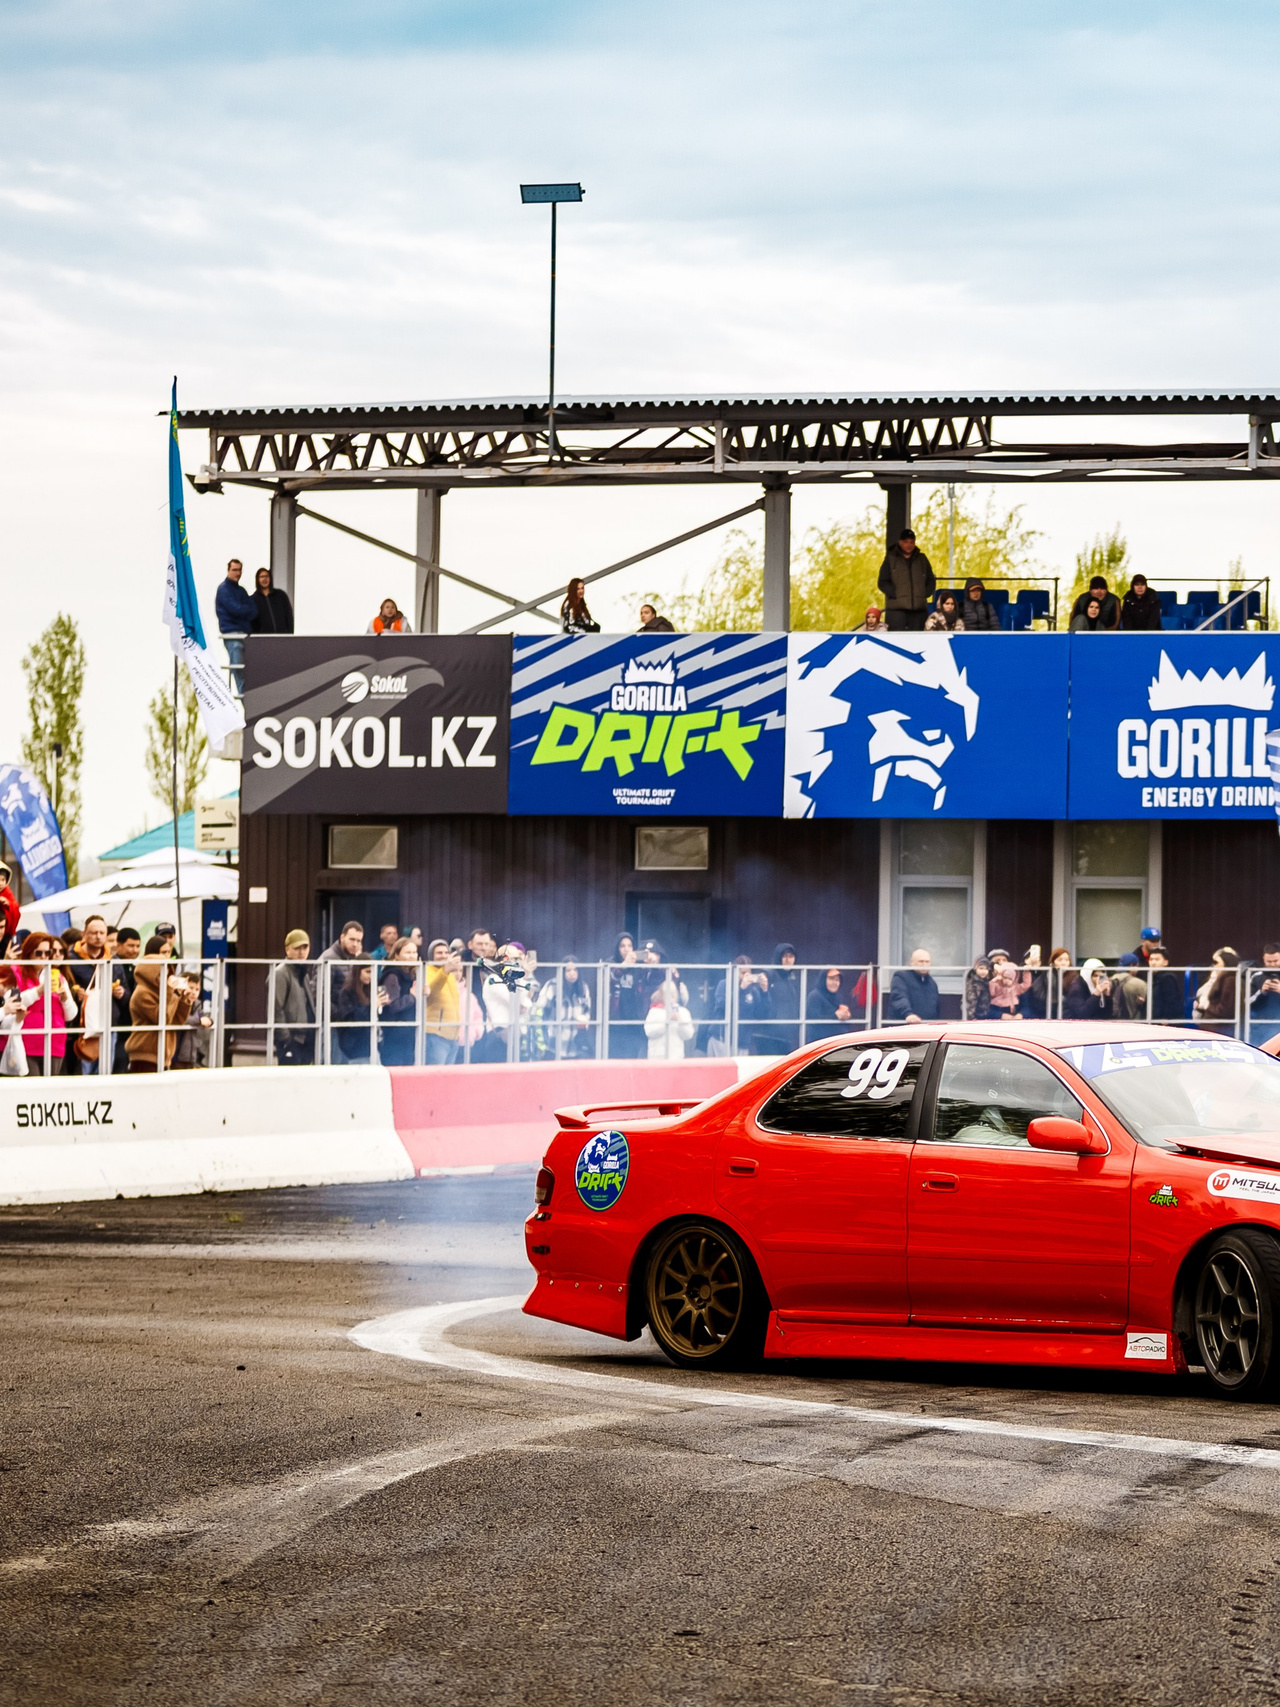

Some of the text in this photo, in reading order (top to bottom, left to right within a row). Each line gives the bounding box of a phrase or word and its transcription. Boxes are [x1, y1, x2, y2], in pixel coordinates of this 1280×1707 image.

[611, 685, 687, 712] GORILLA
[252, 716, 498, 769] SOKOL.KZ
[530, 705, 762, 782] DRIFT
[612, 788, 676, 797] ULTIMATE DRIFT
[616, 797, 672, 805] TOURNAMENT
[1142, 787, 1218, 808] ENERGY
[840, 1048, 910, 1099] 99
[16, 1101, 113, 1127] SOKOL.KZ
[578, 1171, 623, 1192] DRIFT
[1128, 1345, 1165, 1353] АВТОРАДИО
